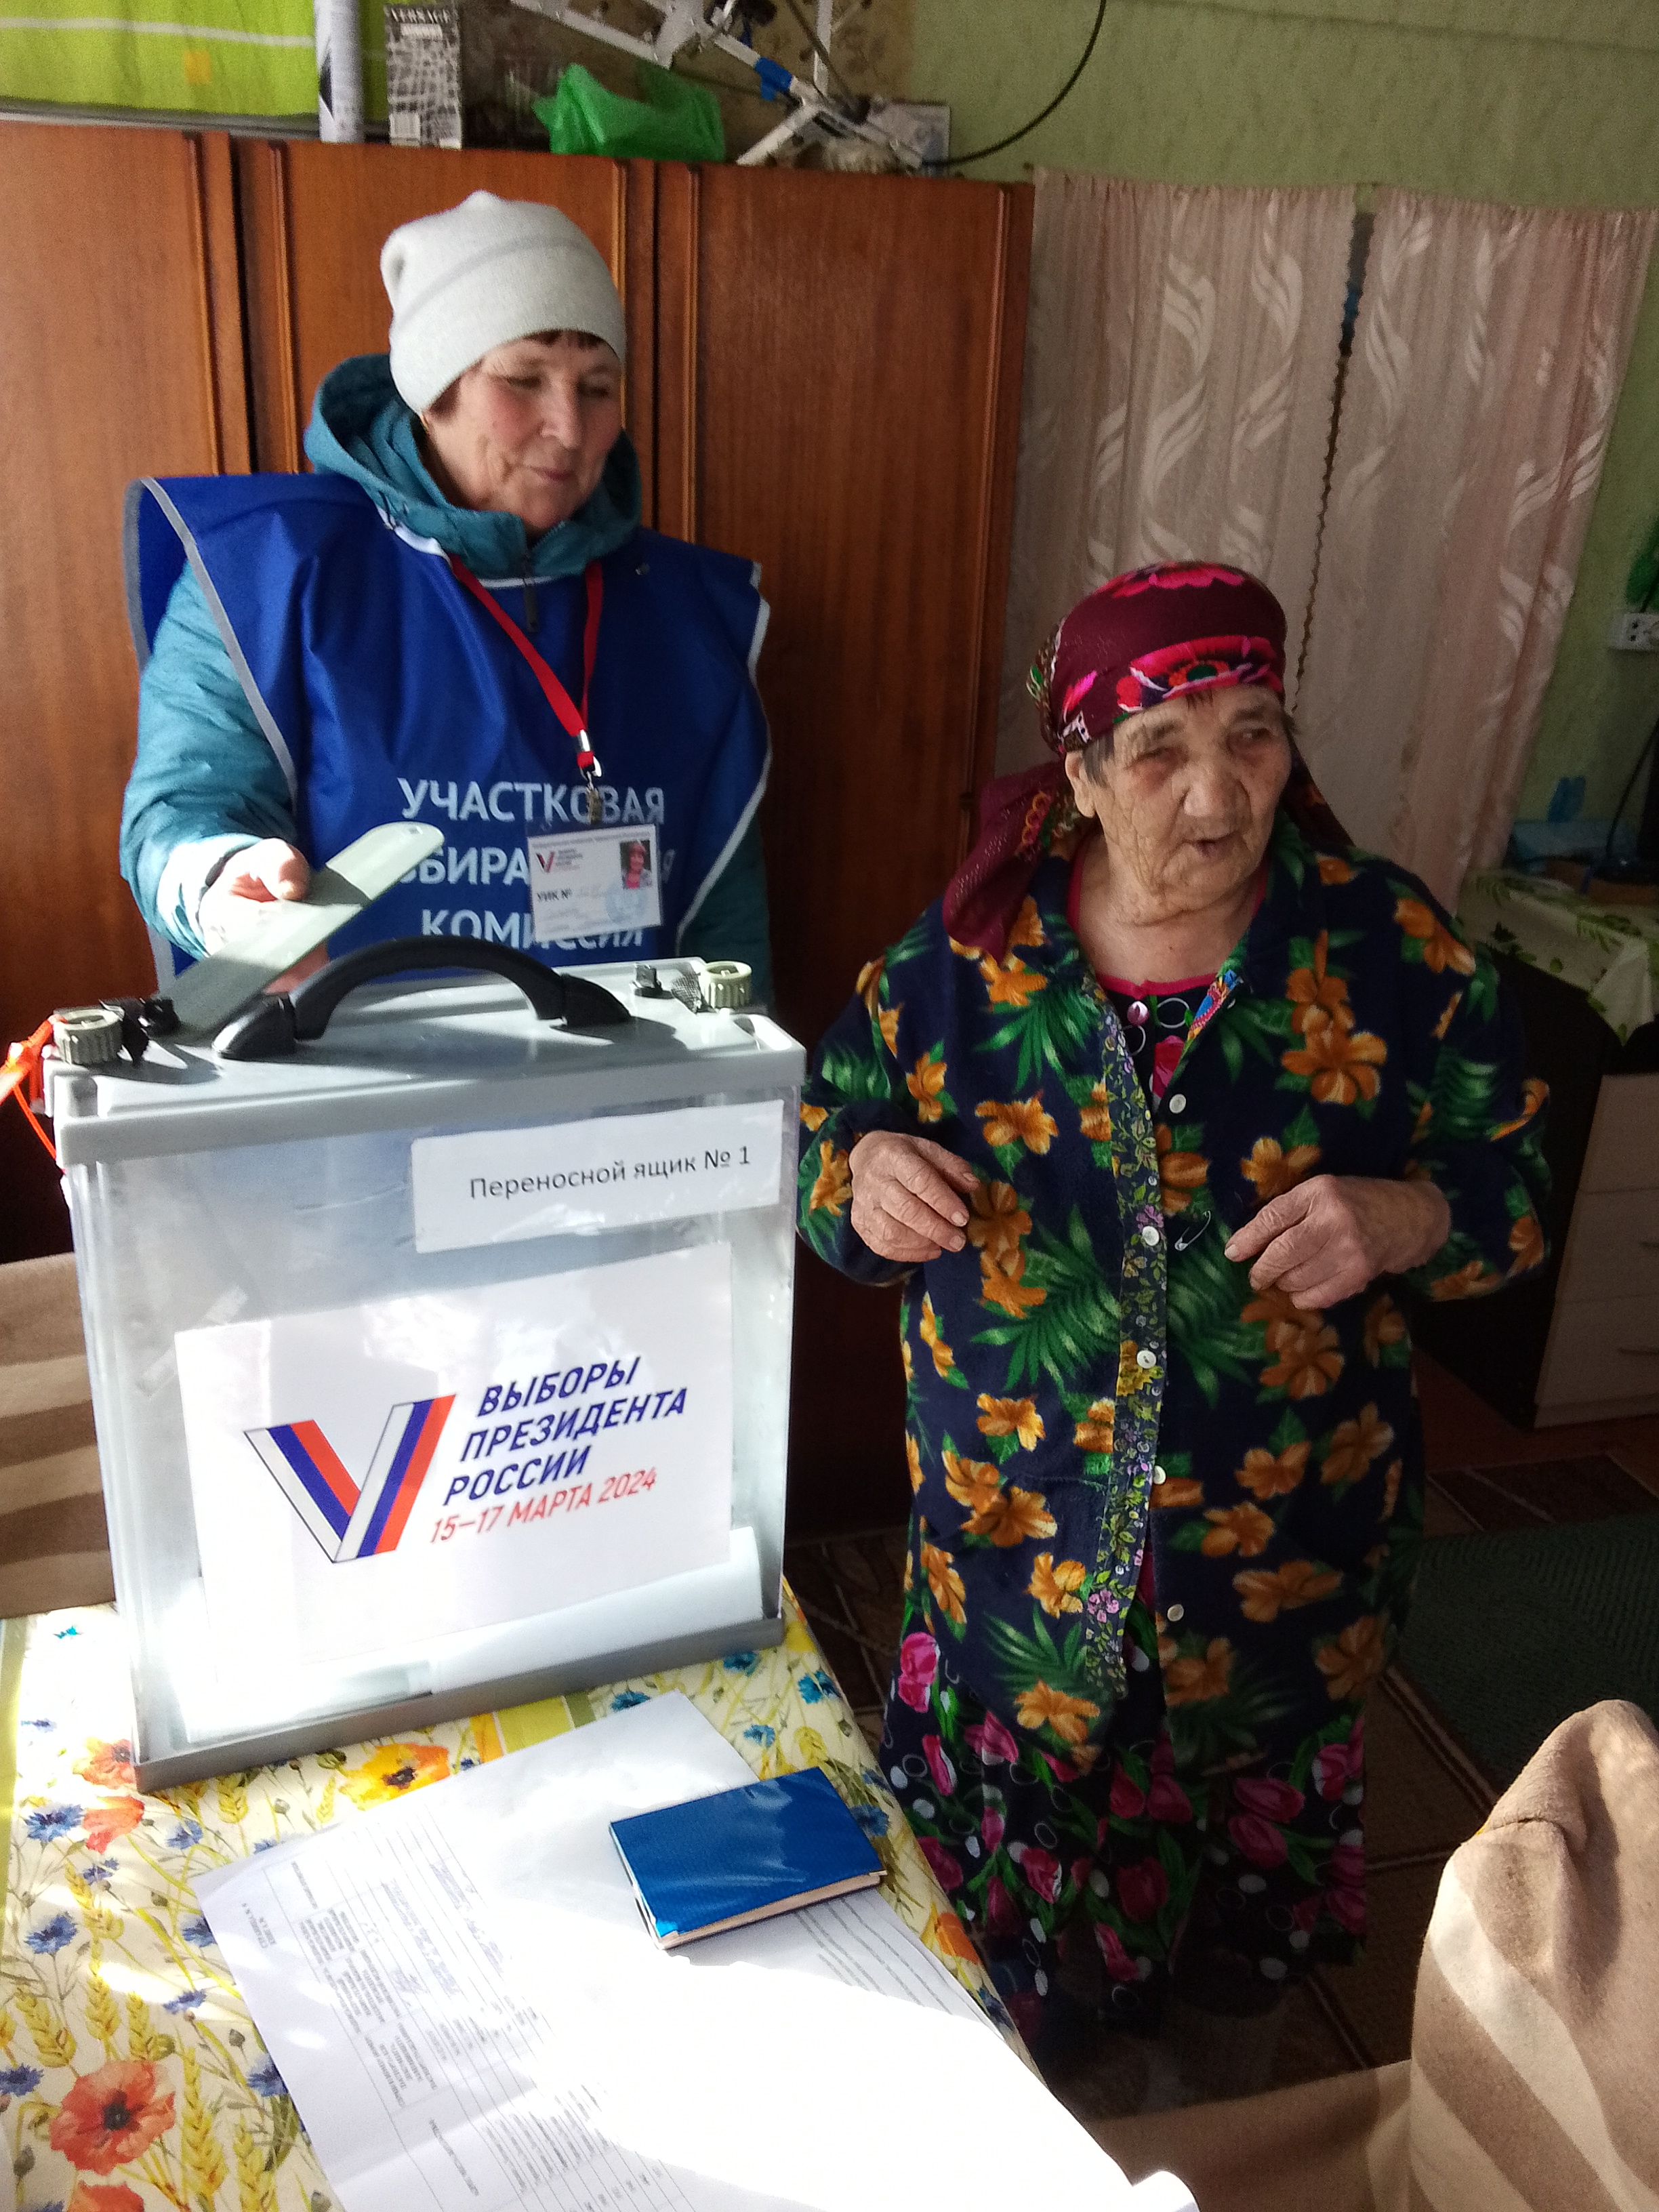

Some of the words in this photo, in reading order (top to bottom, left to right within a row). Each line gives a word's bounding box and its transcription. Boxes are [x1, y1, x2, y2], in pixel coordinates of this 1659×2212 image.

[397, 777, 665, 825] УЧАСТКОВАЯ
[422, 909, 643, 950] КОМИИЯ
[469, 1160, 626, 1200] Переносной
[634, 1157, 696, 1180] ящик
[703, 1148, 731, 1170] №
[739, 1145, 750, 1165] 1
[476, 1356, 642, 1418] ВЫБОРЫ
[459, 1387, 688, 1462] ПРЕЗИДЕНТА
[443, 1445, 592, 1506] РОССИИ
[506, 1482, 593, 1527] МАРТА
[597, 1467, 657, 1504] 2024
